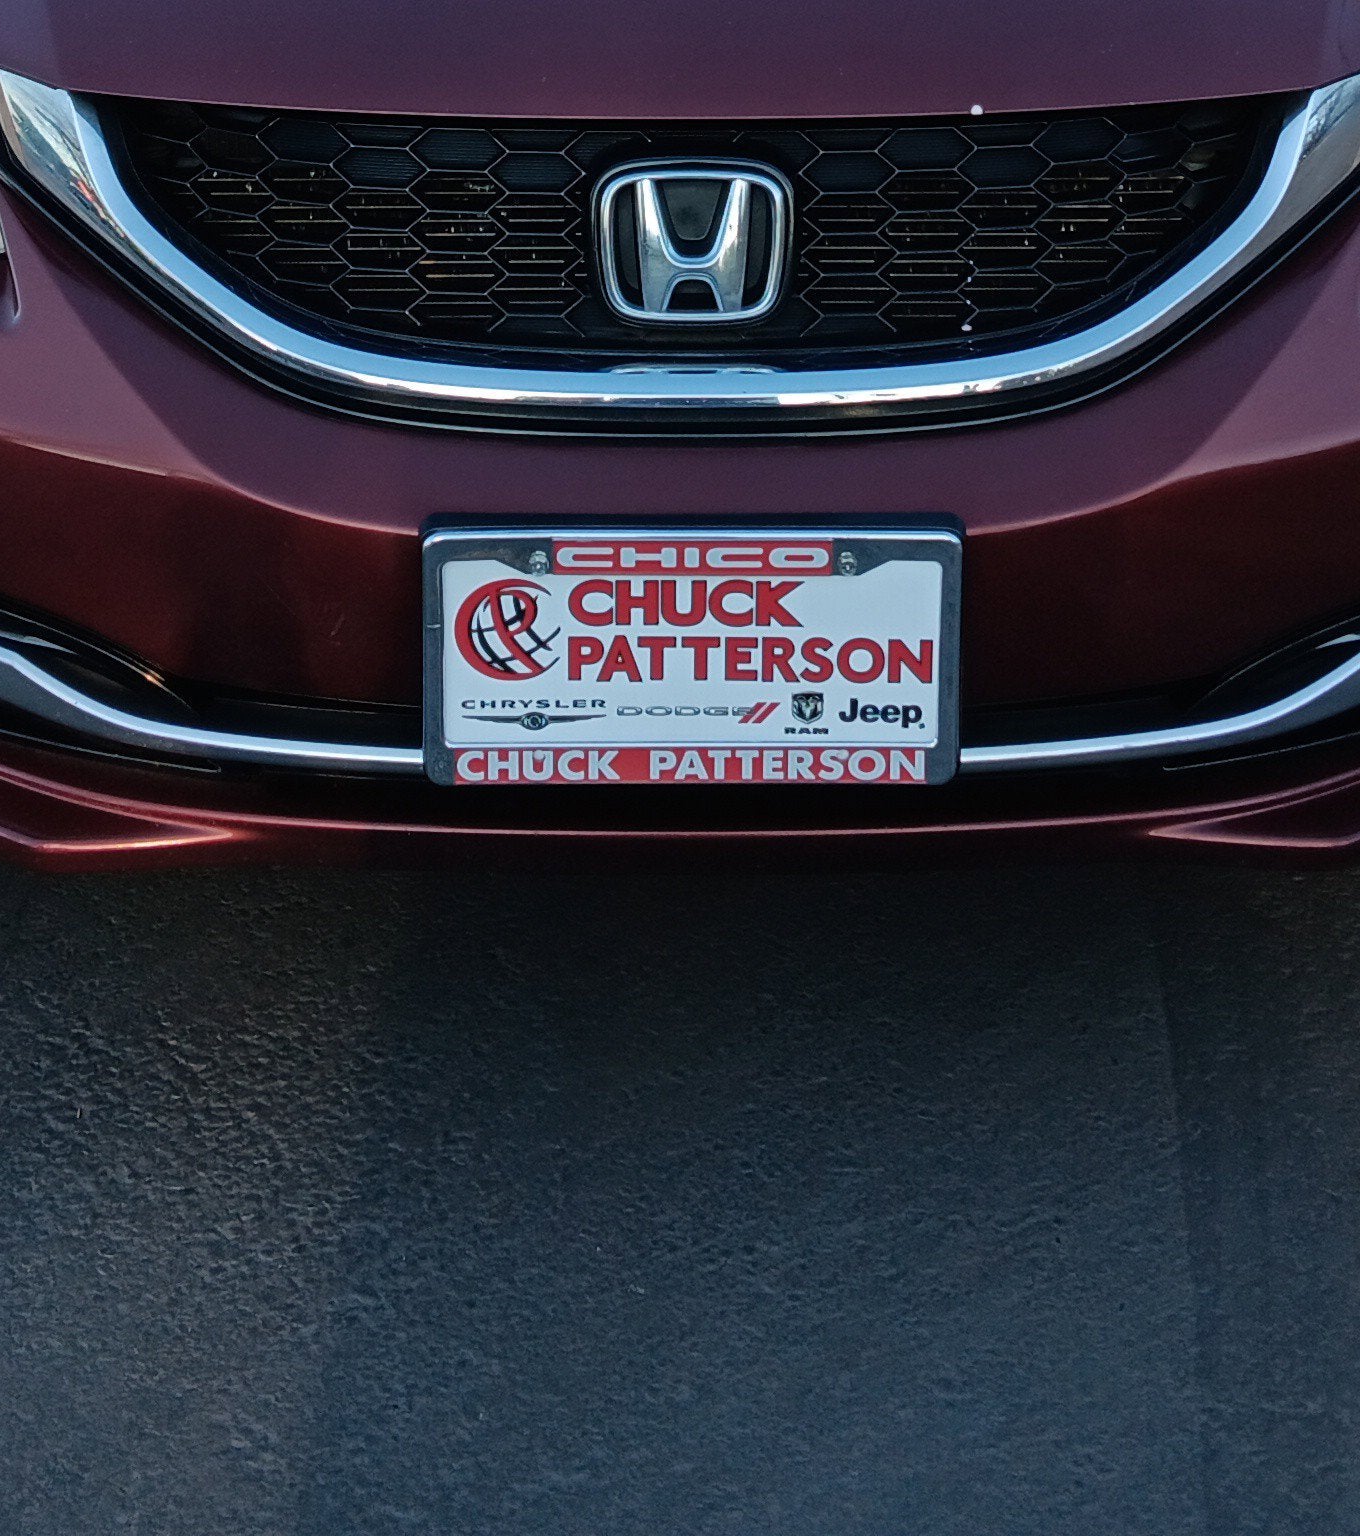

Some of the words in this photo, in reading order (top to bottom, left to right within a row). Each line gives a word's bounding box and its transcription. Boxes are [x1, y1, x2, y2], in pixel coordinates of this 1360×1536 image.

[556, 547, 829, 568] CHICO
[567, 580, 806, 627] CHUCK
[567, 635, 933, 684] PATTERSON
[461, 699, 607, 709] CHRYSLER
[616, 706, 754, 717] DODGE
[838, 698, 923, 728] Jeep
[784, 726, 829, 735] RAM
[456, 750, 621, 782] CHUCK
[650, 749, 926, 782] PATTERSON
